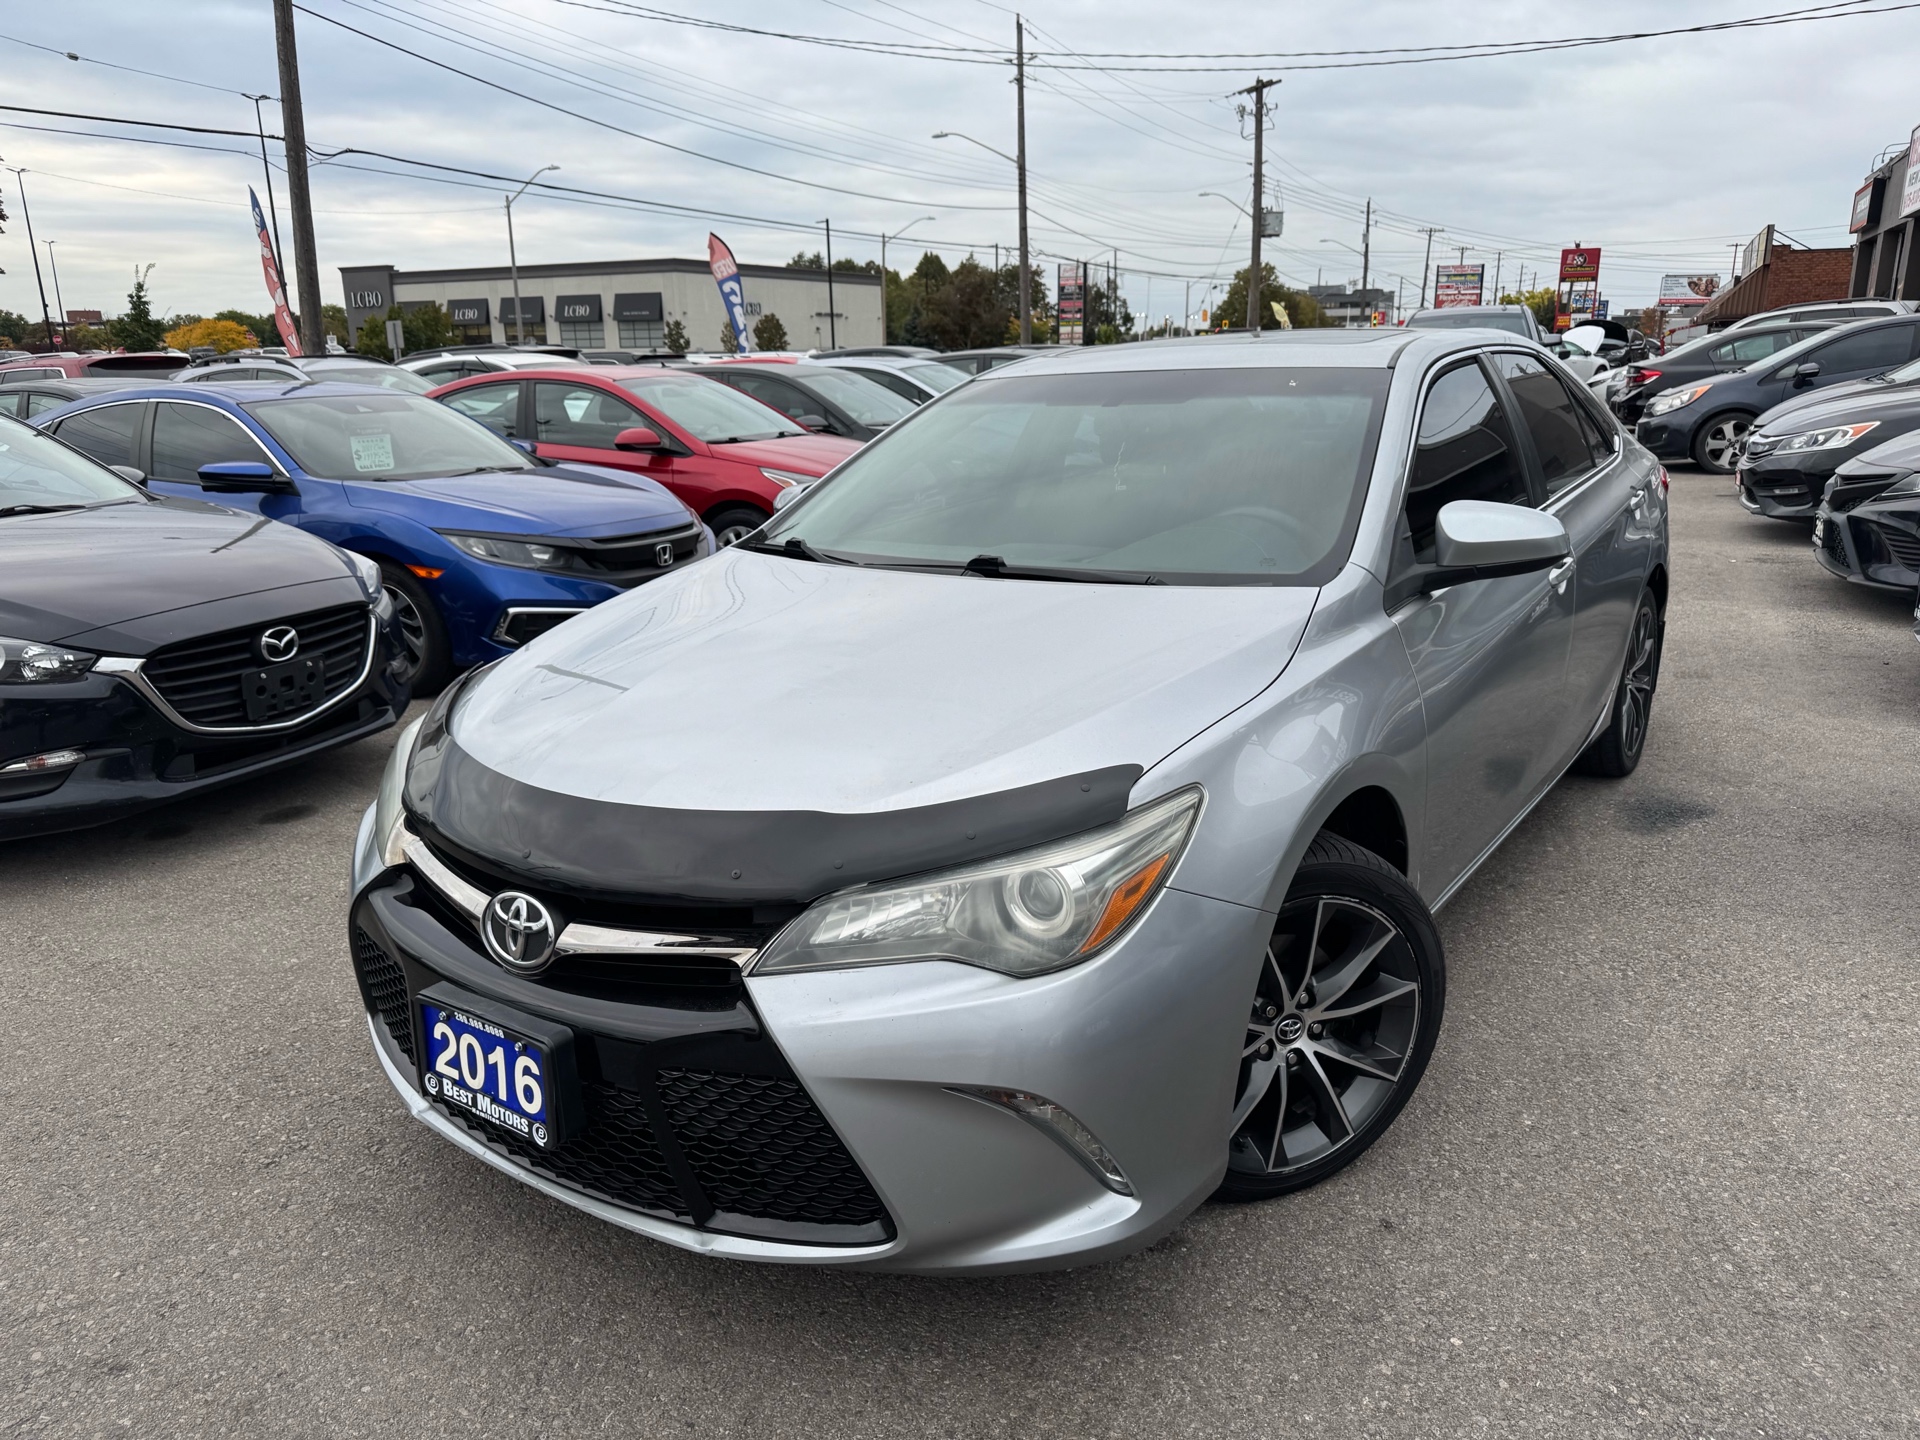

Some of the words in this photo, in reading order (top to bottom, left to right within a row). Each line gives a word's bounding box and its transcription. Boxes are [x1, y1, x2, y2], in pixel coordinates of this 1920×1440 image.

[351, 291, 382, 307] LCBO
[454, 308, 478, 320] LCBO
[564, 304, 590, 317] LCBO
[433, 1022, 542, 1115] 2016
[442, 1077, 473, 1106] BEST
[476, 1092, 529, 1133] MOTORS
[471, 1107, 500, 1125] Hamilton
